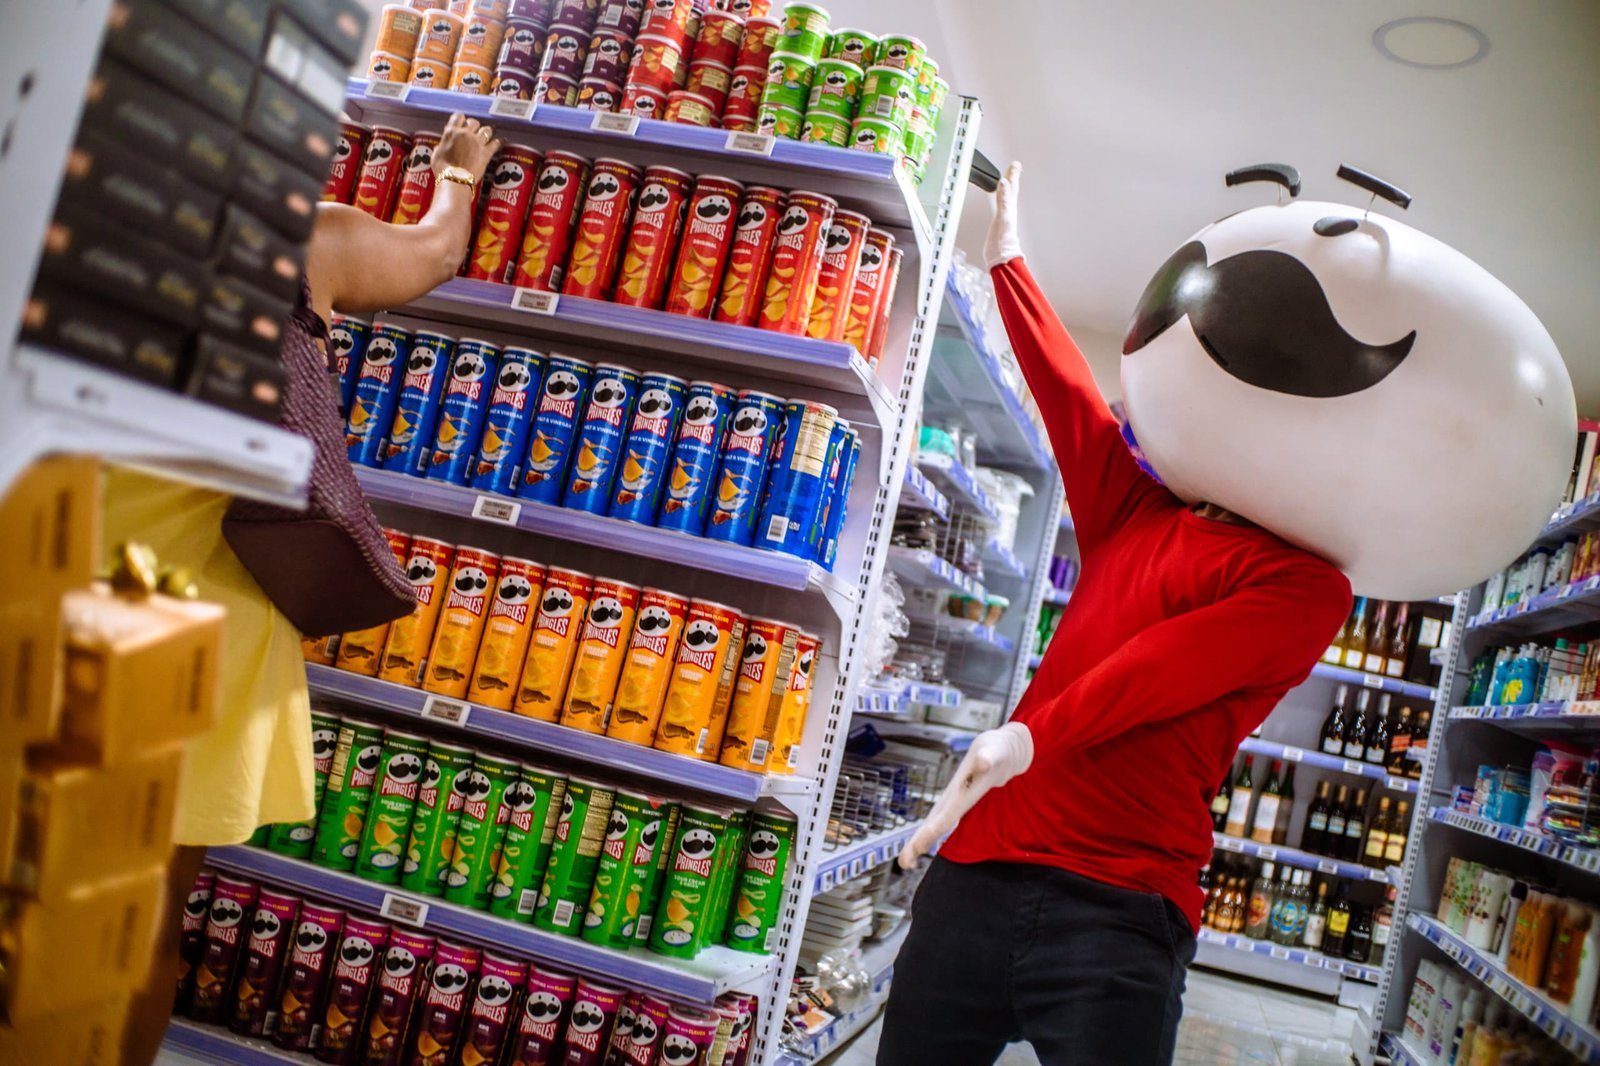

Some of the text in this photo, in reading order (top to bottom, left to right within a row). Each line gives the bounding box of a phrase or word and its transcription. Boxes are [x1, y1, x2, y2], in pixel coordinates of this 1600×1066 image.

[690, 218, 726, 242] PRINGLES
[540, 394, 576, 420] PRINGLES
[586, 402, 623, 428] PRINGLES
[632, 414, 670, 438] PRINGLES
[680, 423, 714, 446] PRINGLES
[728, 433, 765, 457] PRINGLES
[448, 590, 484, 615] PRINGLES
[492, 600, 527, 623] PRINGLES
[584, 622, 618, 647] PRINGLES
[632, 632, 667, 656] PRINGLES
[678, 645, 714, 670] PRINGLES
[381, 776, 418, 802] PRINGLES
[676, 852, 712, 878] PRINGLES
[428, 986, 463, 1012] PRINGLES
[472, 998, 507, 1024] PRINGLES
[520, 1014, 556, 1041] PRINGLES
[566, 1024, 599, 1051] PRINGLES
